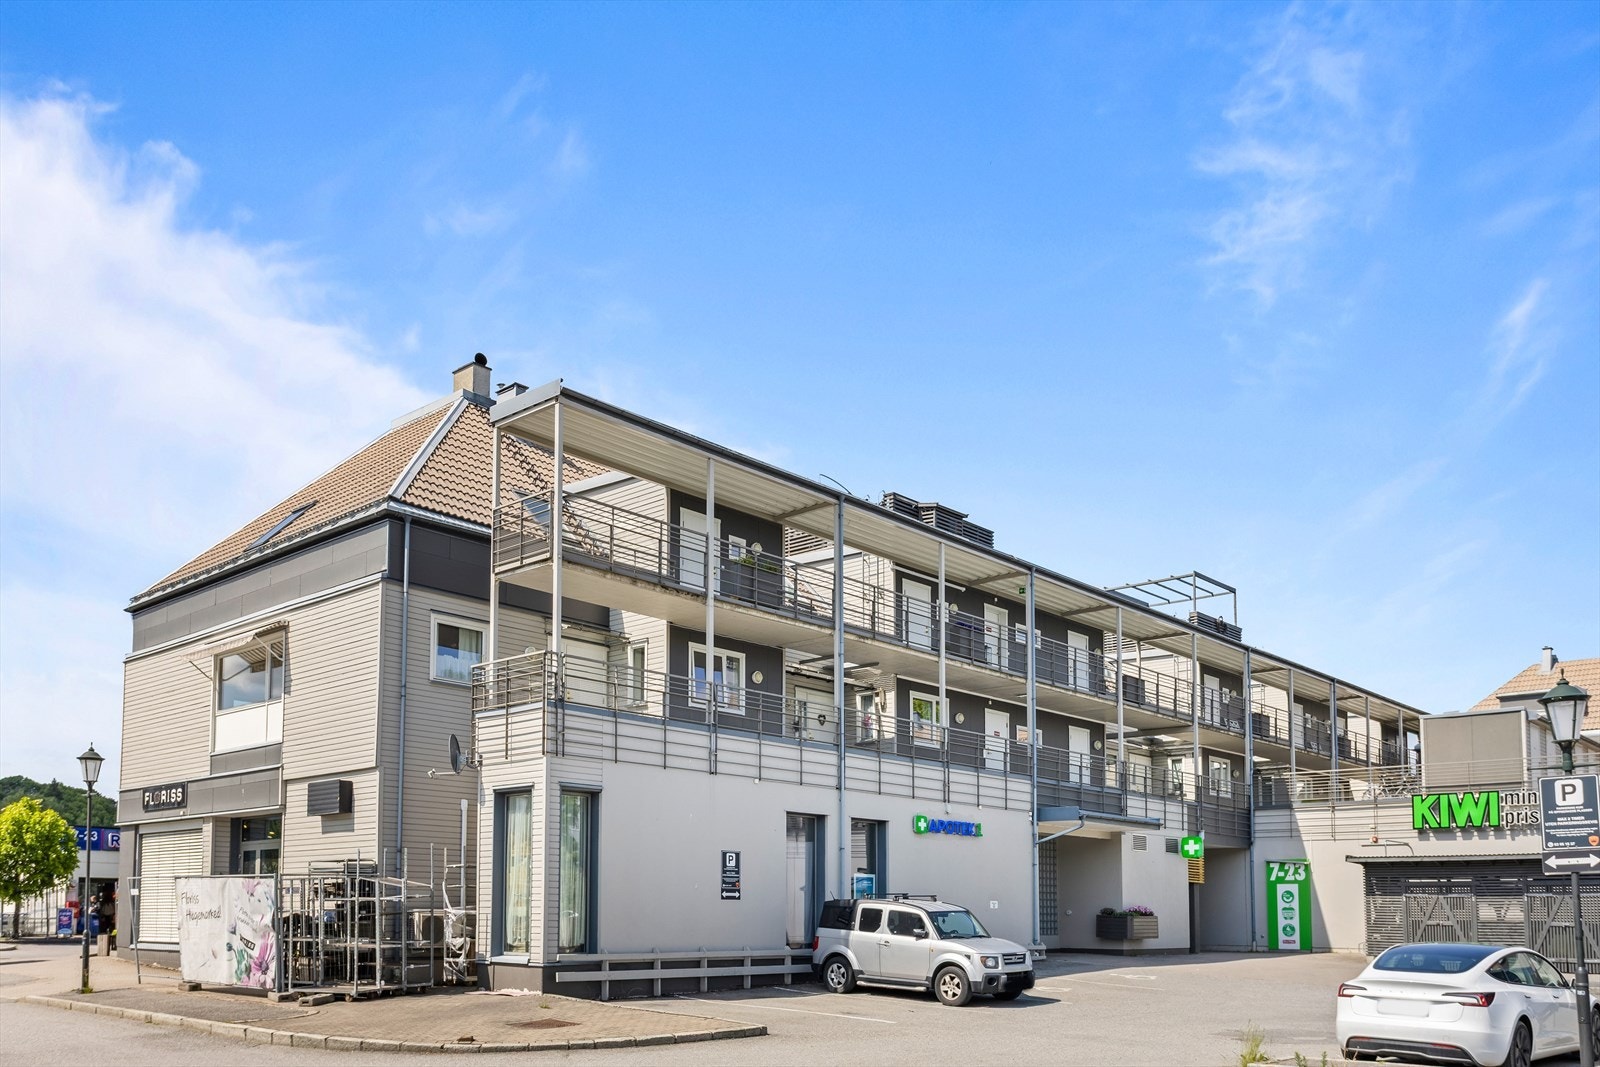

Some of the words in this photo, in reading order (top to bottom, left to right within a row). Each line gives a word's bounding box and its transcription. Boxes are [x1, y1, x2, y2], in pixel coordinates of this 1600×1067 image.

[144, 787, 183, 806] FLORISS
[1503, 788, 1539, 805] min
[1560, 783, 1577, 802] P
[1412, 790, 1500, 830] KIWI
[1504, 807, 1540, 828] pris
[928, 819, 975, 837] APOTEK
[975, 823, 983, 837] 1
[1269, 862, 1306, 881] 7-23
